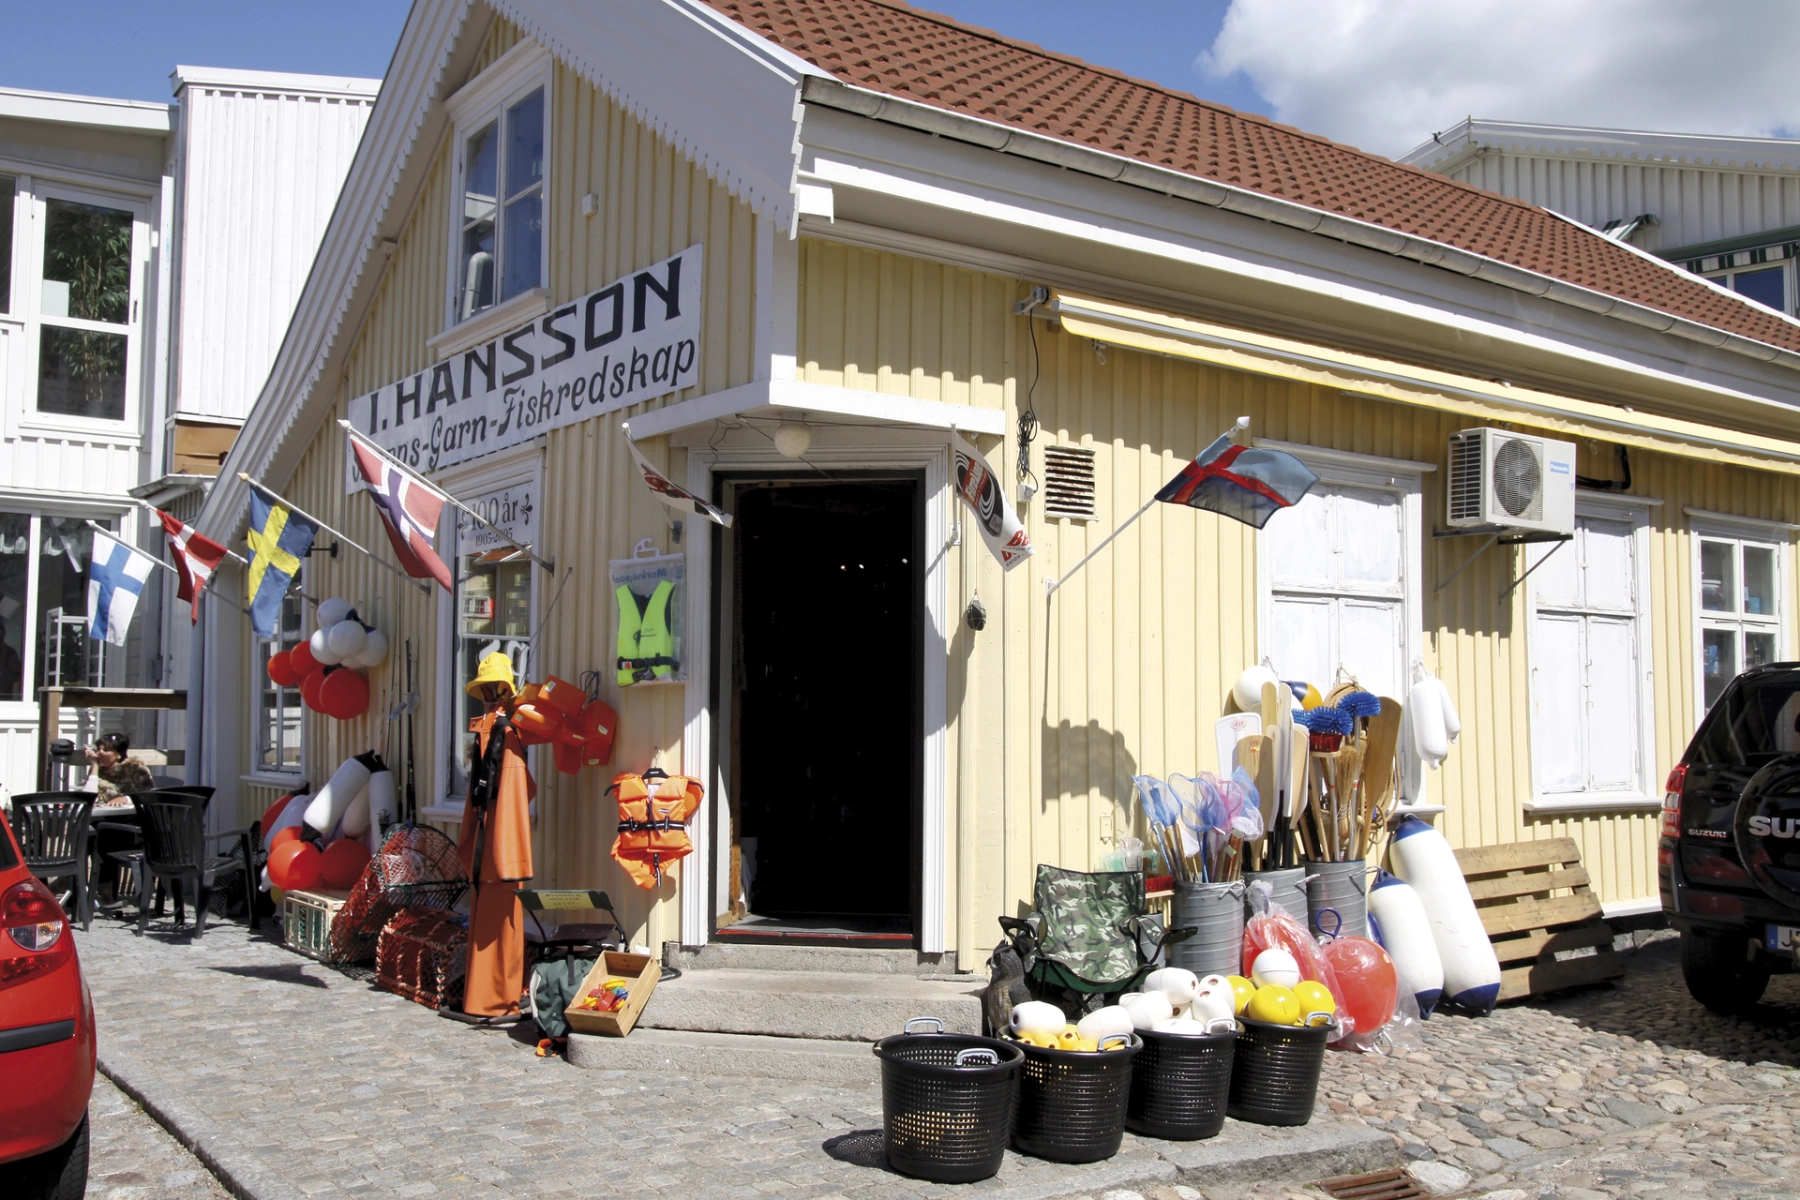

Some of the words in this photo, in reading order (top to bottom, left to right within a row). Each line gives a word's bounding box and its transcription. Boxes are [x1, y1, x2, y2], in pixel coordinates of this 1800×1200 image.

[471, 497, 500, 531] 100
[502, 492, 518, 523] år
[1688, 828, 1727, 838] SUZUKI
